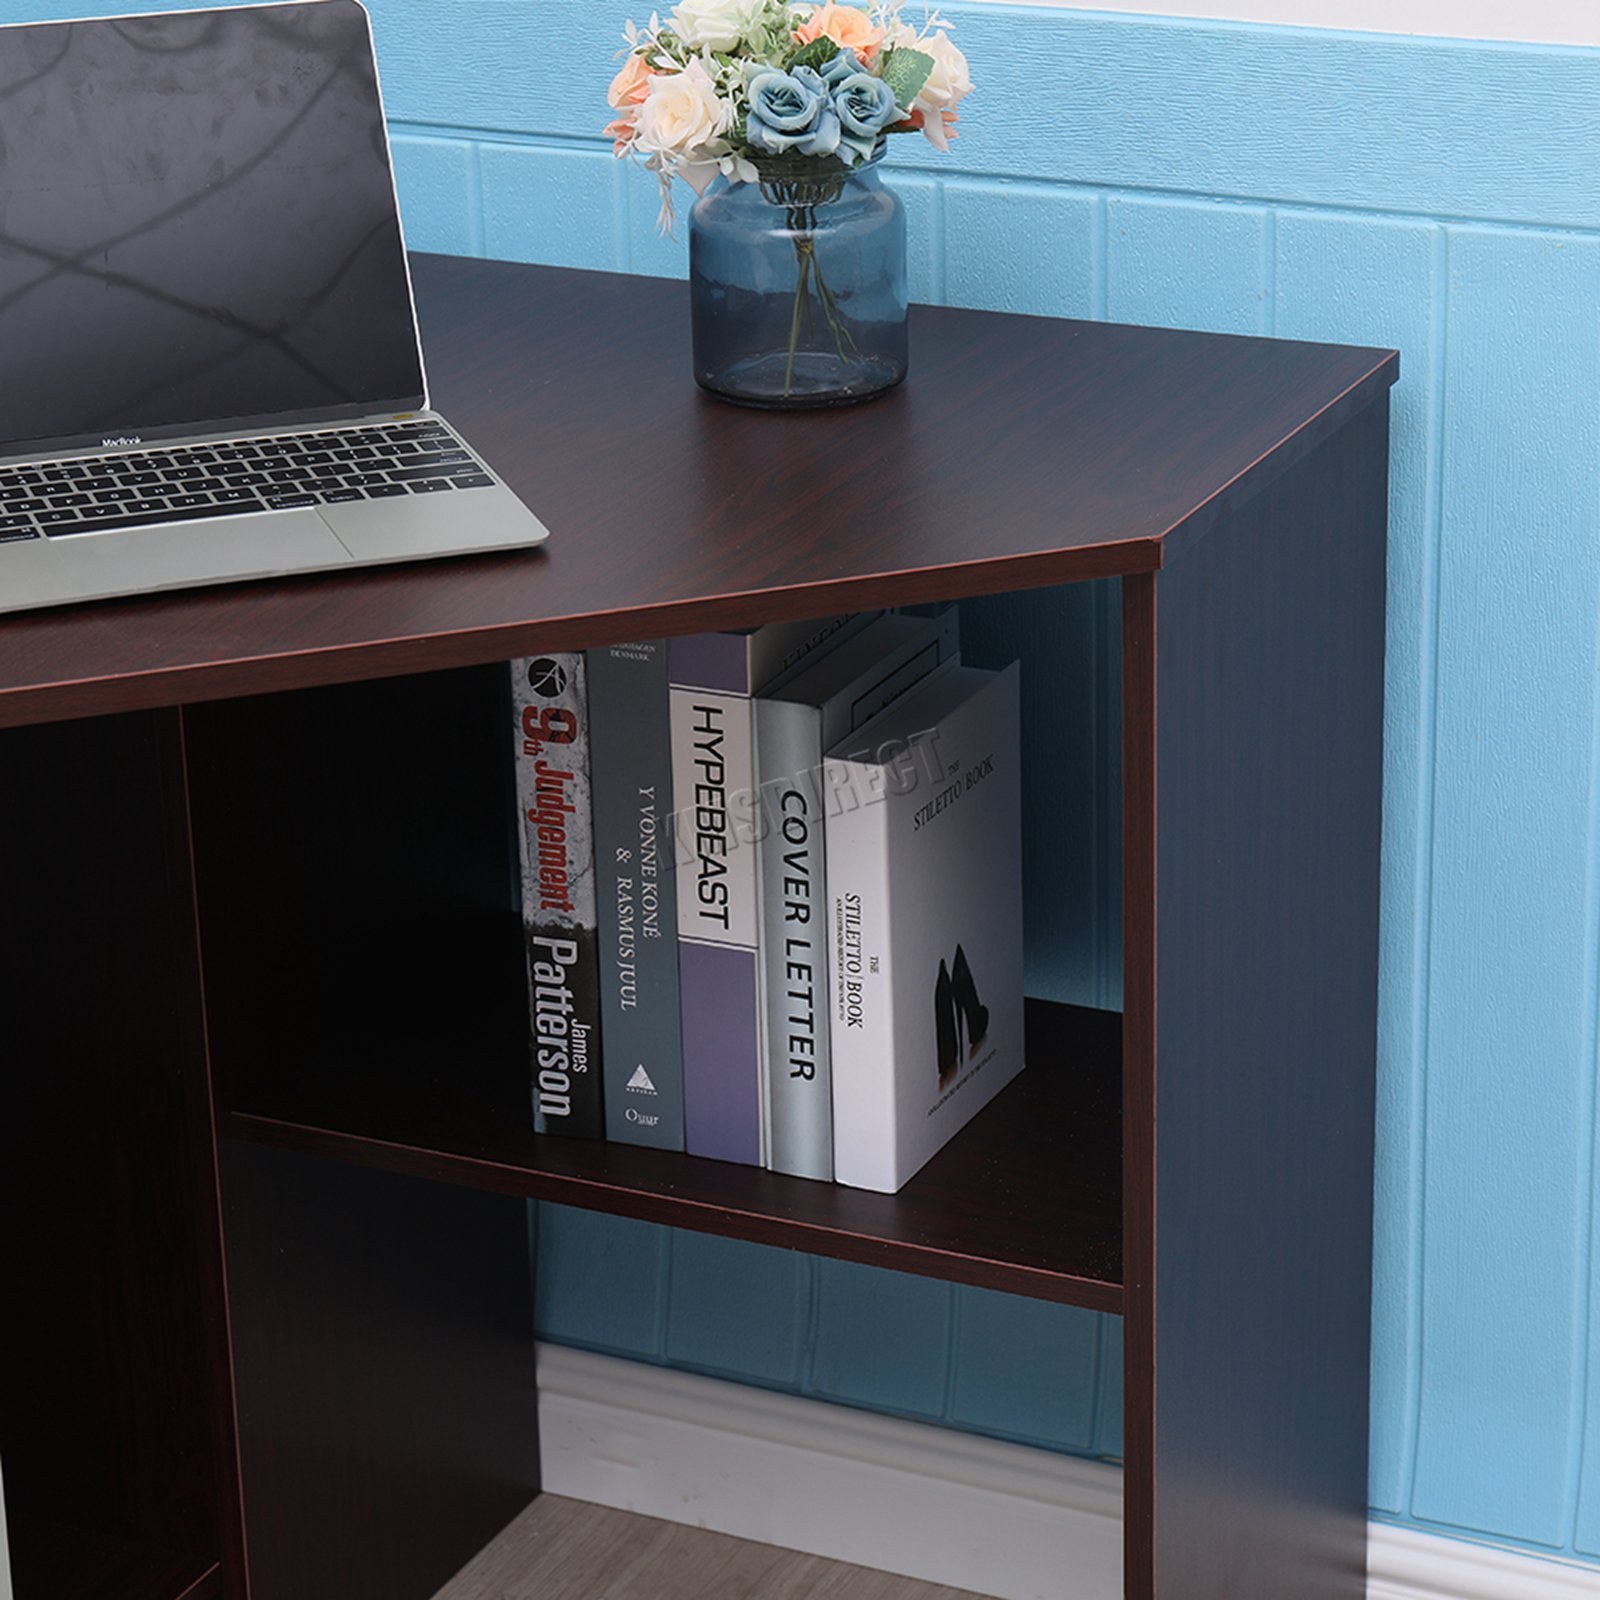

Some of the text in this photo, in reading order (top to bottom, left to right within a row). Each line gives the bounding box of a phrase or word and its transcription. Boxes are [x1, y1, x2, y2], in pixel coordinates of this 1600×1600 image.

[102, 436, 141, 447] MacBook
[528, 760, 577, 913] Judgement
[692, 705, 729, 930] HYPEBEAST
[616, 848, 636, 1010] & RASMUS JUUL
[641, 880, 662, 939] KONÉ
[781, 790, 815, 1081] COVER LETTER
[845, 893, 863, 1029] STILETTO BOOK
[532, 936, 578, 1117] Patterson
[571, 1018, 591, 1073] James
